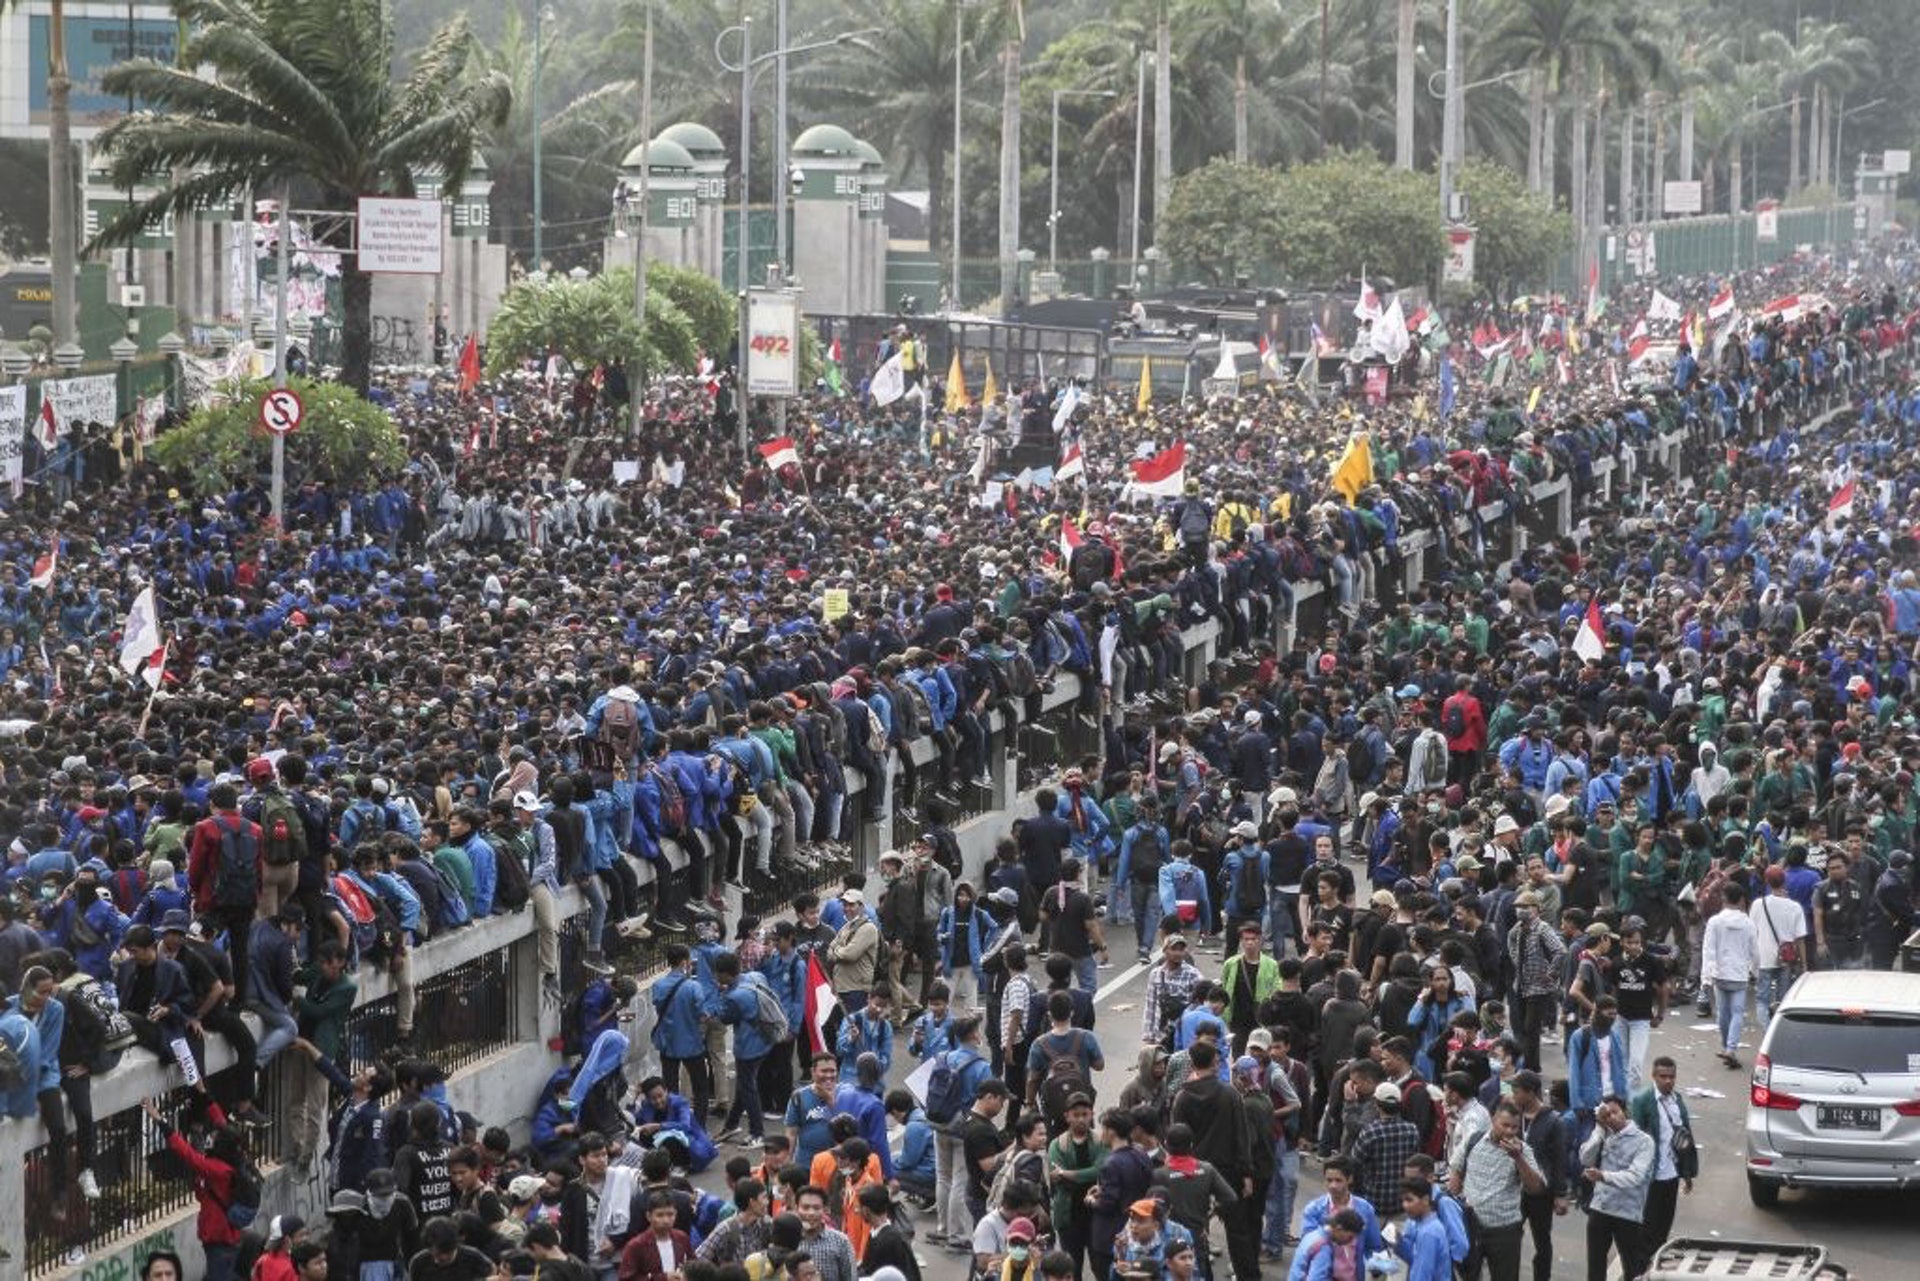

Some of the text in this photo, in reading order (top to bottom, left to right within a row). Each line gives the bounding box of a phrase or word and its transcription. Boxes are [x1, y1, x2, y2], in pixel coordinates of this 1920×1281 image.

[750, 334, 790, 353] 492
[272, 397, 289, 426] S
[420, 1182, 451, 1195] WER
[421, 1197, 451, 1212] HER
